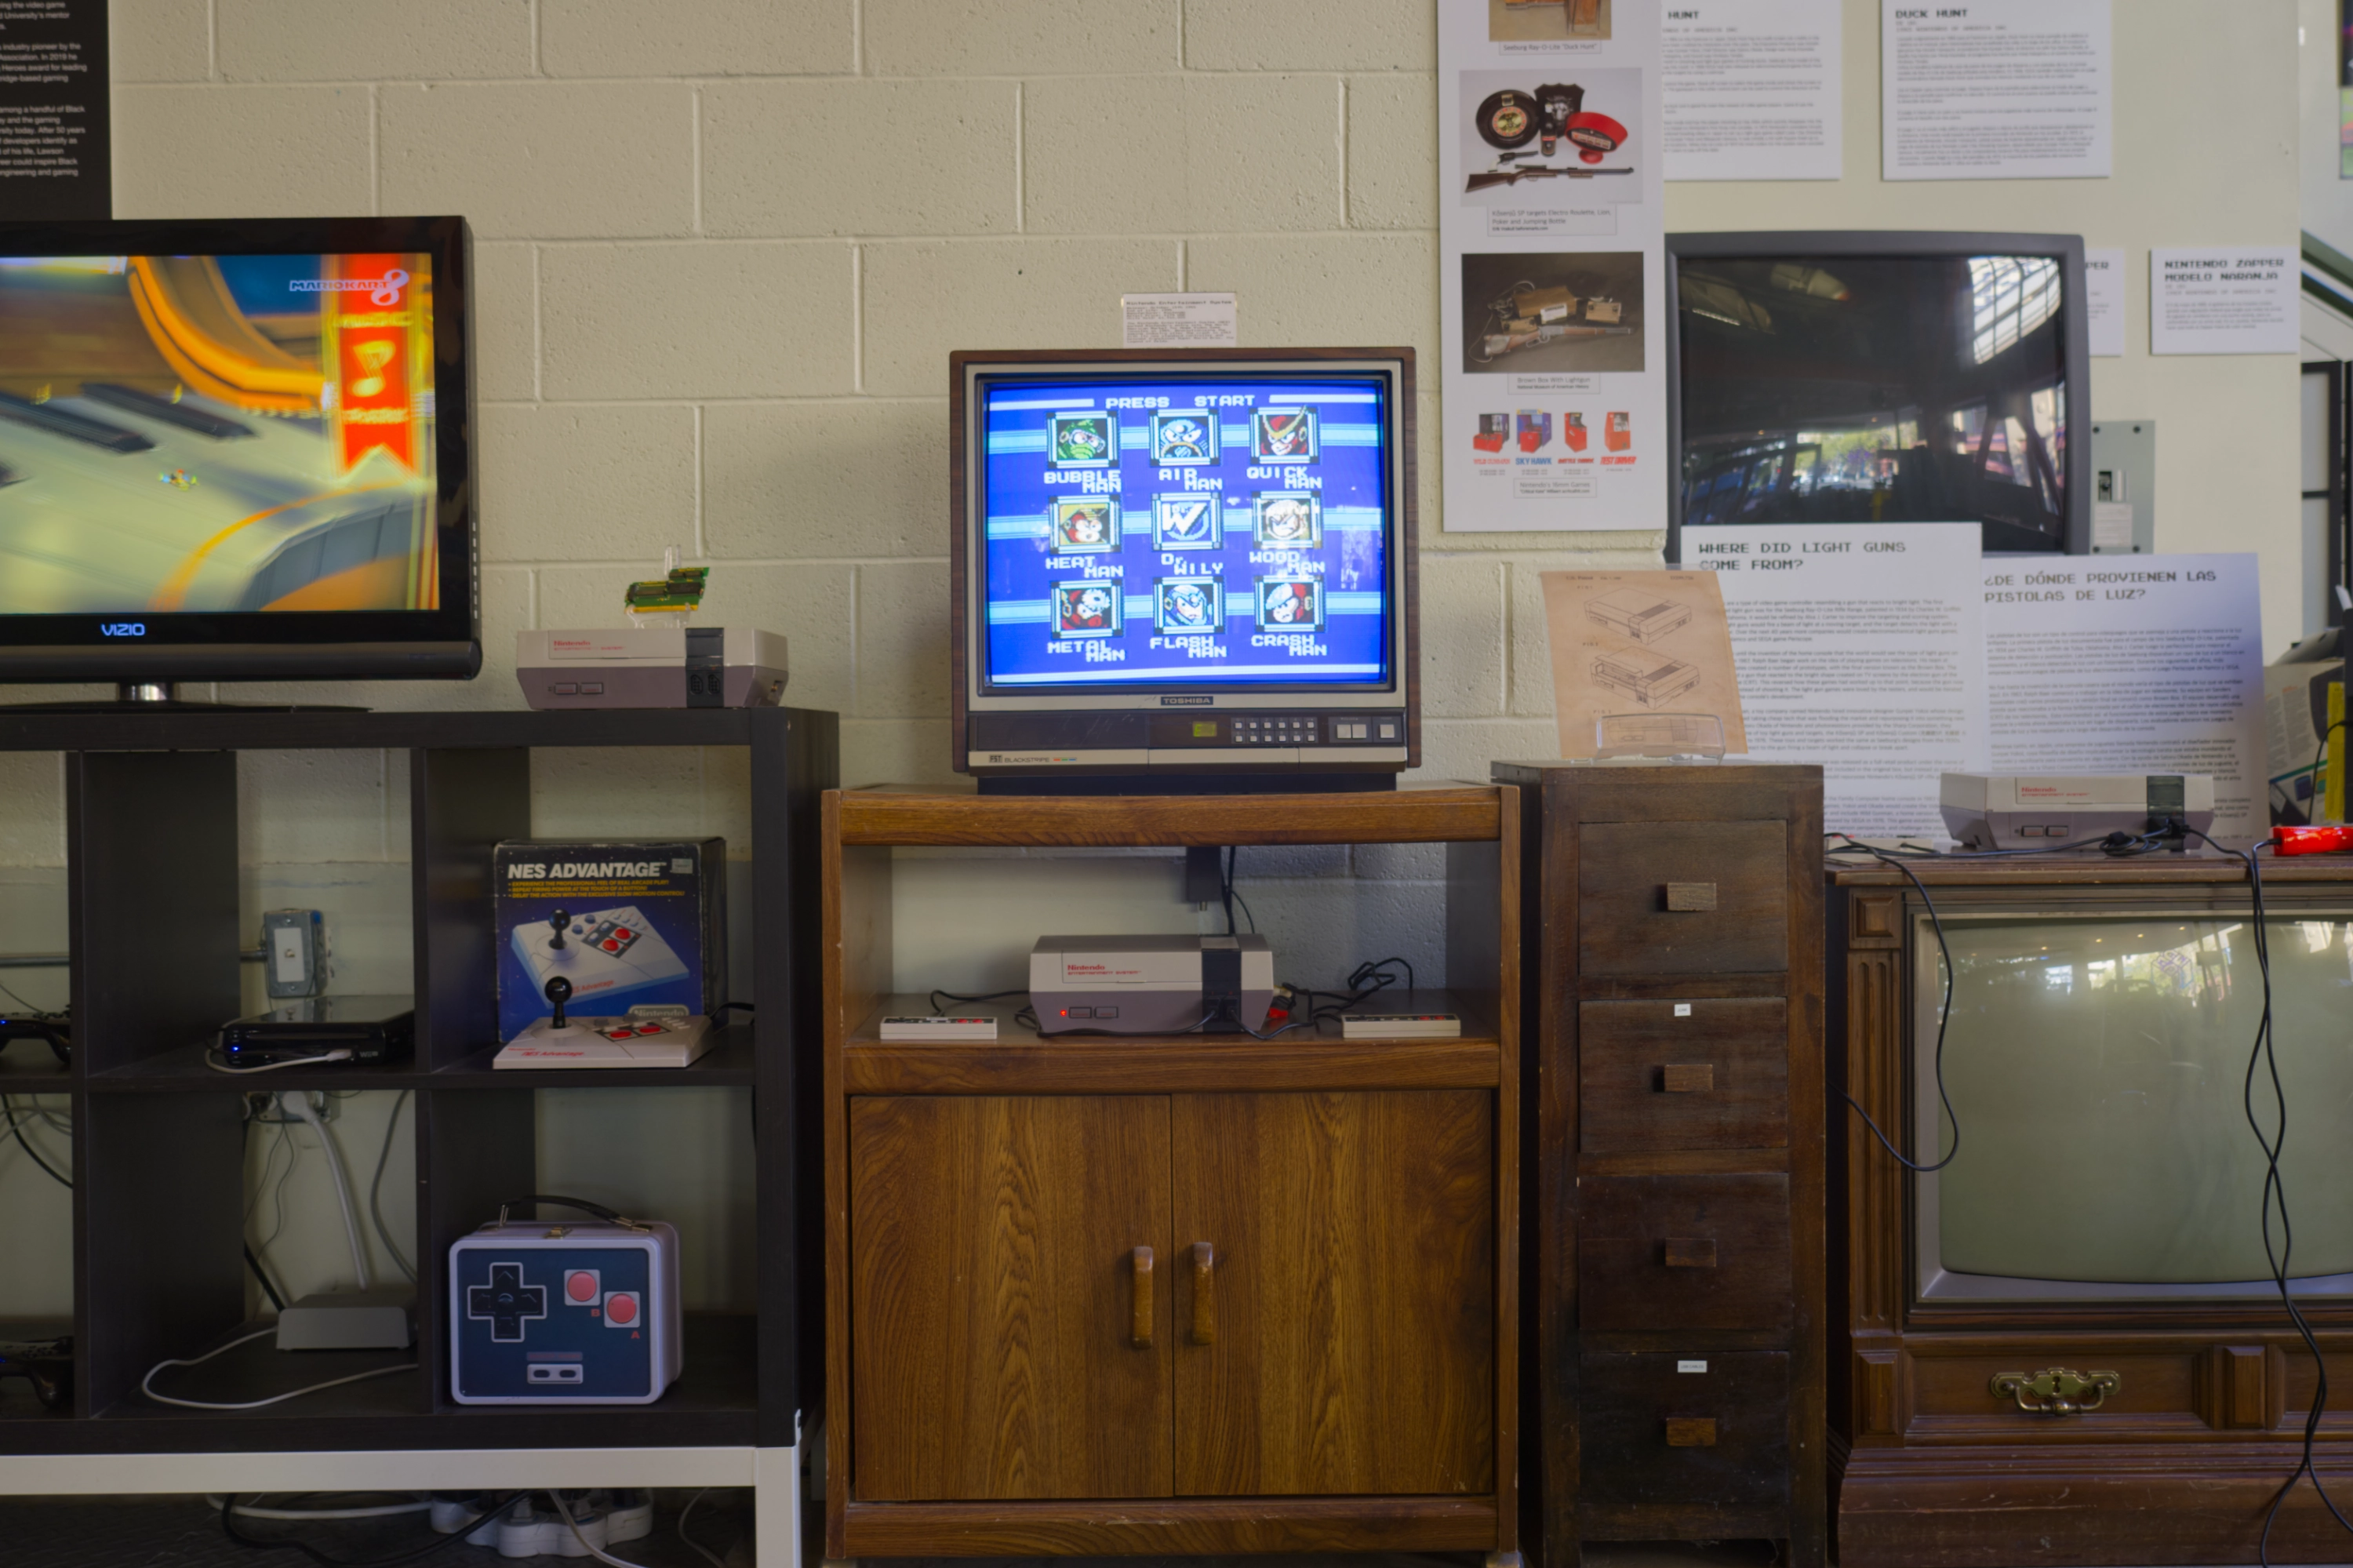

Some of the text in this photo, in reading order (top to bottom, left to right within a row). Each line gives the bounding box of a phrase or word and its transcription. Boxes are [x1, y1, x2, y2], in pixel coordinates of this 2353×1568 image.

[1668, 10, 1700, 20] HUNT
[1895, 9, 1968, 19] DUCK HUNT
[2165, 258, 2284, 269] NINTENDO ZAPPER
[2165, 271, 2278, 282] MODELO NARANJA
[371, 269, 409, 306] 8
[1105, 395, 1255, 408] PRESS START
[1044, 470, 1122, 484] BUBBLE
[1159, 468, 1197, 481] AIR
[1247, 466, 1308, 479] QUICK
[1082, 481, 1122, 493] MAN
[1184, 478, 1223, 491] MAN
[1285, 476, 1322, 489] MAN
[1699, 542, 1906, 554] WHERE DID LIGHT GUNS
[1046, 556, 1096, 569] HEAT
[1161, 553, 1185, 566] Dr.
[1250, 552, 1300, 564] WOOD
[1084, 565, 1124, 578] MAN
[1174, 562, 1223, 575] WILY
[1288, 561, 1325, 573] MAN
[1700, 559, 1804, 571] COME FROM?
[1984, 570, 2216, 587] ¿DE DÓNDE PROVIENEN LAS
[1985, 589, 2146, 603] PISTOLAS DE LUZ?
[101, 624, 145, 637] VIZIO
[1048, 640, 1110, 653] METAL
[1150, 636, 1214, 649] FLASH
[1252, 635, 1315, 647] CRASH
[1087, 649, 1125, 662] MAN
[1188, 645, 1227, 658] MAN
[1289, 644, 1327, 656] MAN
[507, 862, 661, 879] NES ADVANTAGE
[581, 979, 614, 993] Advantage
